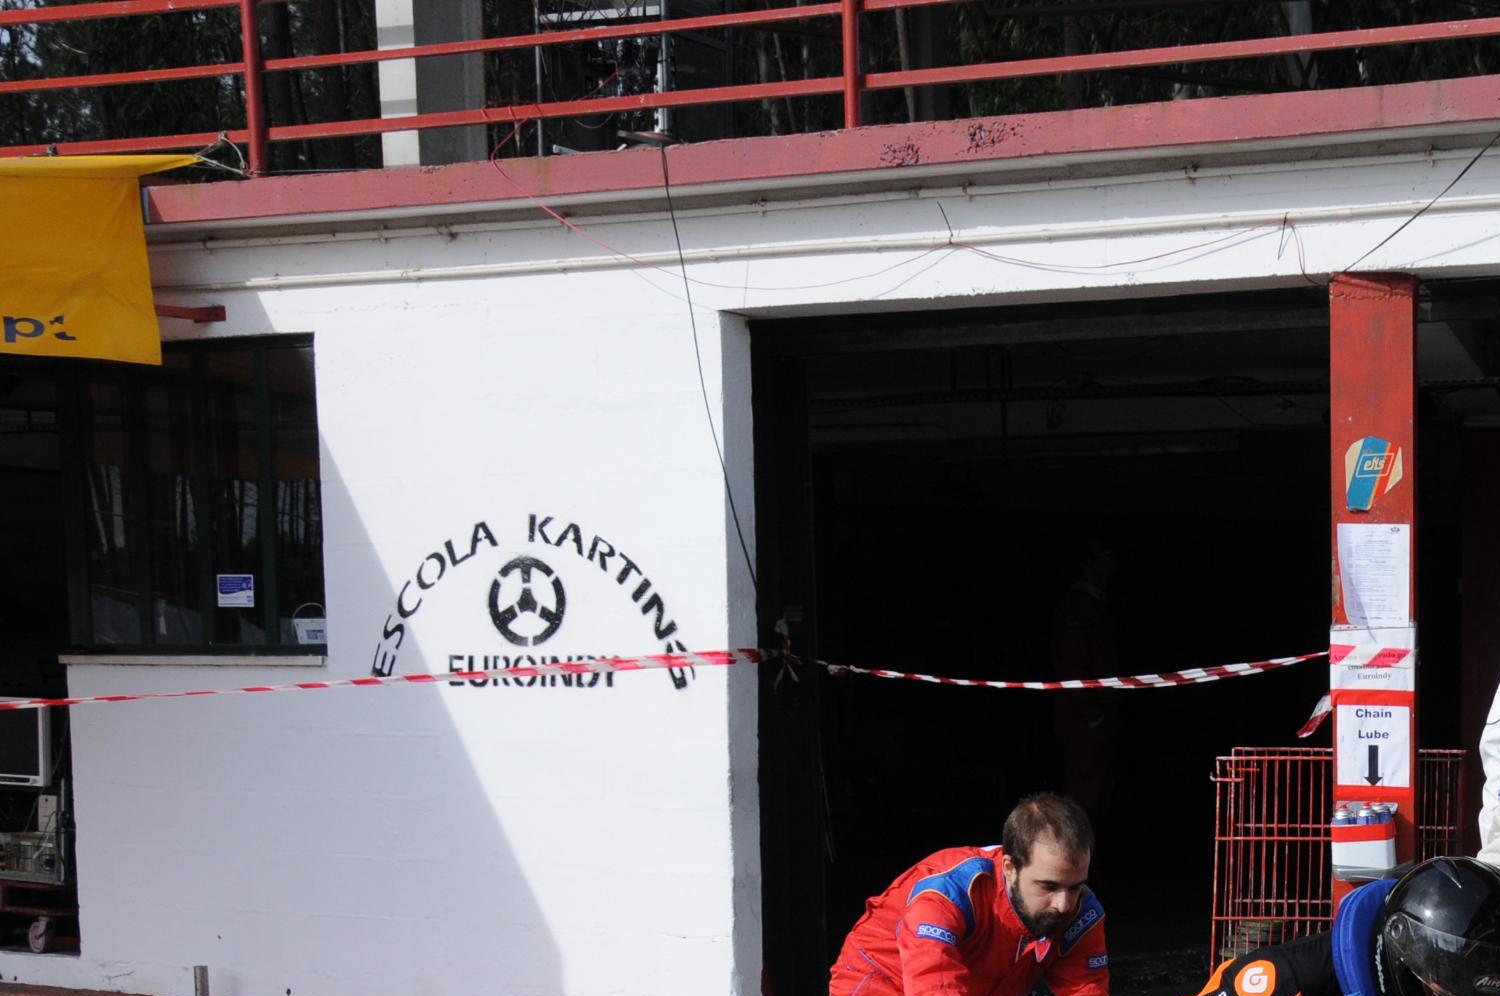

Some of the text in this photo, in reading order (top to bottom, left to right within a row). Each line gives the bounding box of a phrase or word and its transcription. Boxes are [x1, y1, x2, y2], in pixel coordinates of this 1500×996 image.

[371, 521, 499, 678] ESCOLA
[448, 654, 622, 688] EUROINDY
[1355, 708, 1393, 719] Chain
[1358, 729, 1390, 740] Lube
